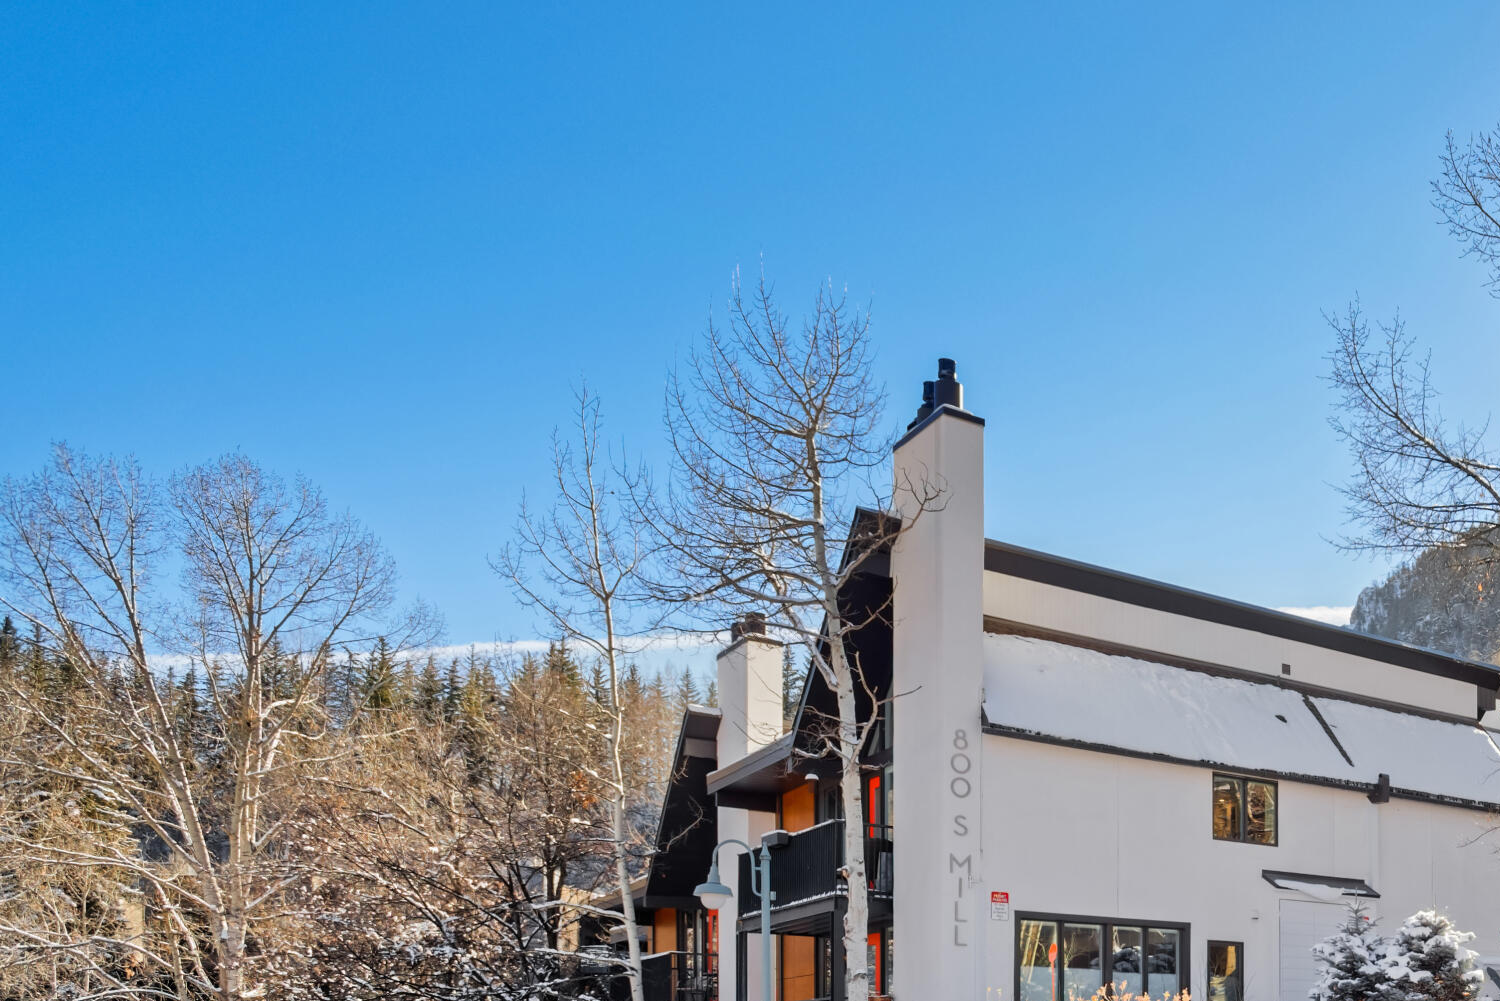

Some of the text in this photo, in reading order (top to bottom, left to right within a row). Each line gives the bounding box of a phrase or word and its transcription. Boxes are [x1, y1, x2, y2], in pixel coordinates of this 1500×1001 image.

[949, 729, 972, 947] 800 S MILL
